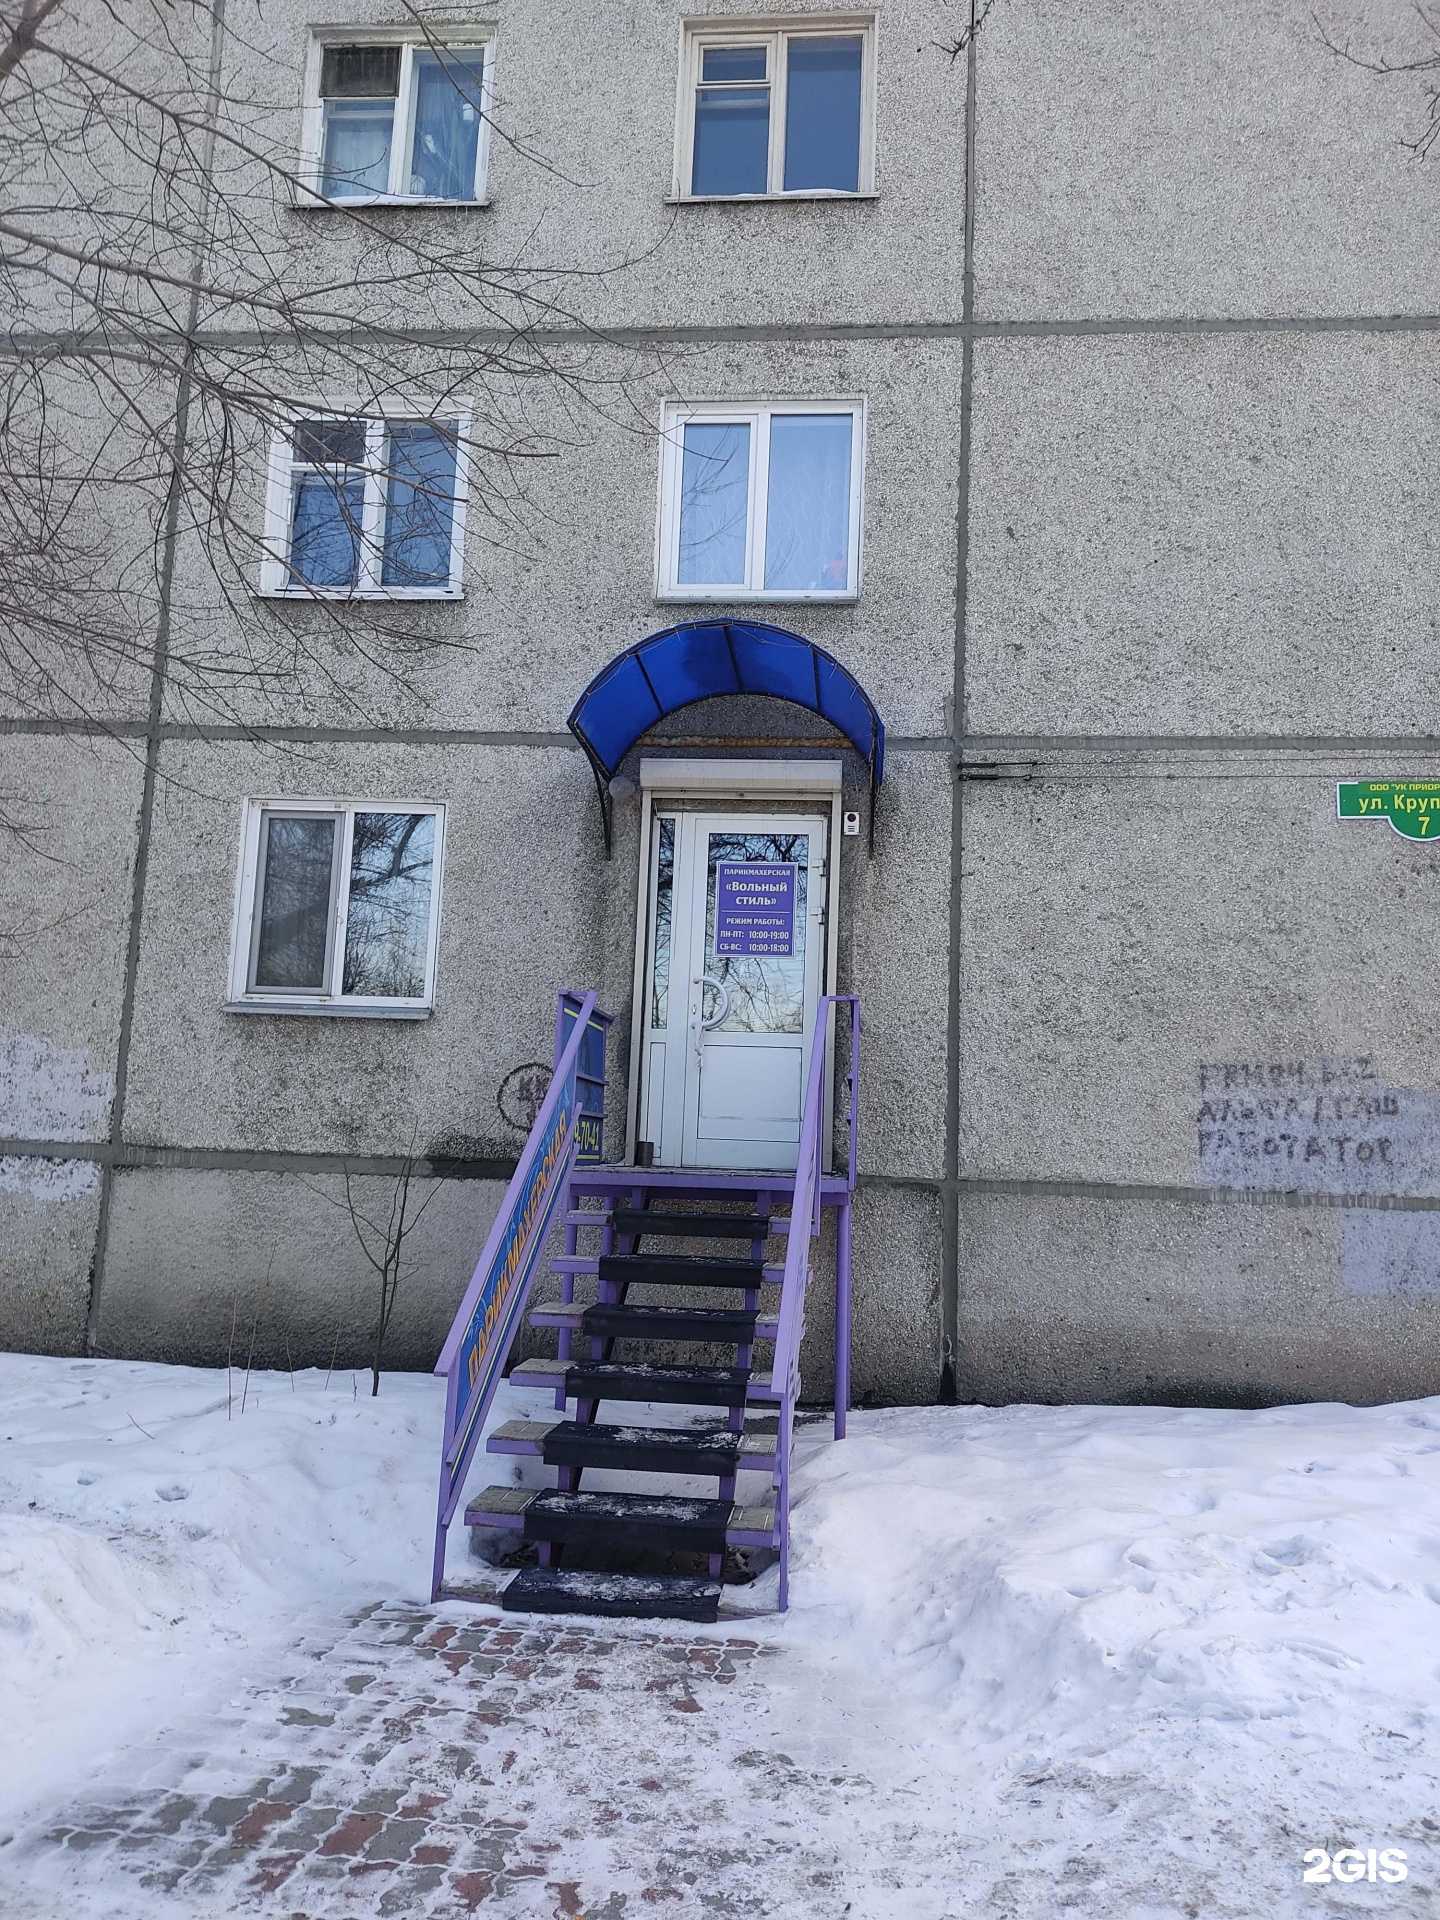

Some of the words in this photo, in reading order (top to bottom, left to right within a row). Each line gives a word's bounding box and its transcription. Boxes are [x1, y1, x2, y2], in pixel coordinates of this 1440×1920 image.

[1359, 798, 1388, 813] ул.
[1394, 794, 1440, 813] Круп
[1418, 816, 1430, 835] 7
[724, 868, 791, 876] ПАРИКМАХЕРСКАЯ
[726, 881, 788, 892] «Вольный
[726, 917, 752, 925] РЕЖИМ
[753, 918, 785, 926] РАБОТЫ:
[720, 930, 745, 938] ПН-ПТ:
[749, 930, 789, 940] 10:00-19:00
[720, 943, 742, 951] СБ-ВС:
[749, 943, 789, 952] 10:00-18:00
[468, 1109, 566, 1388] ПАРИКМАХЕРСКАЯ
